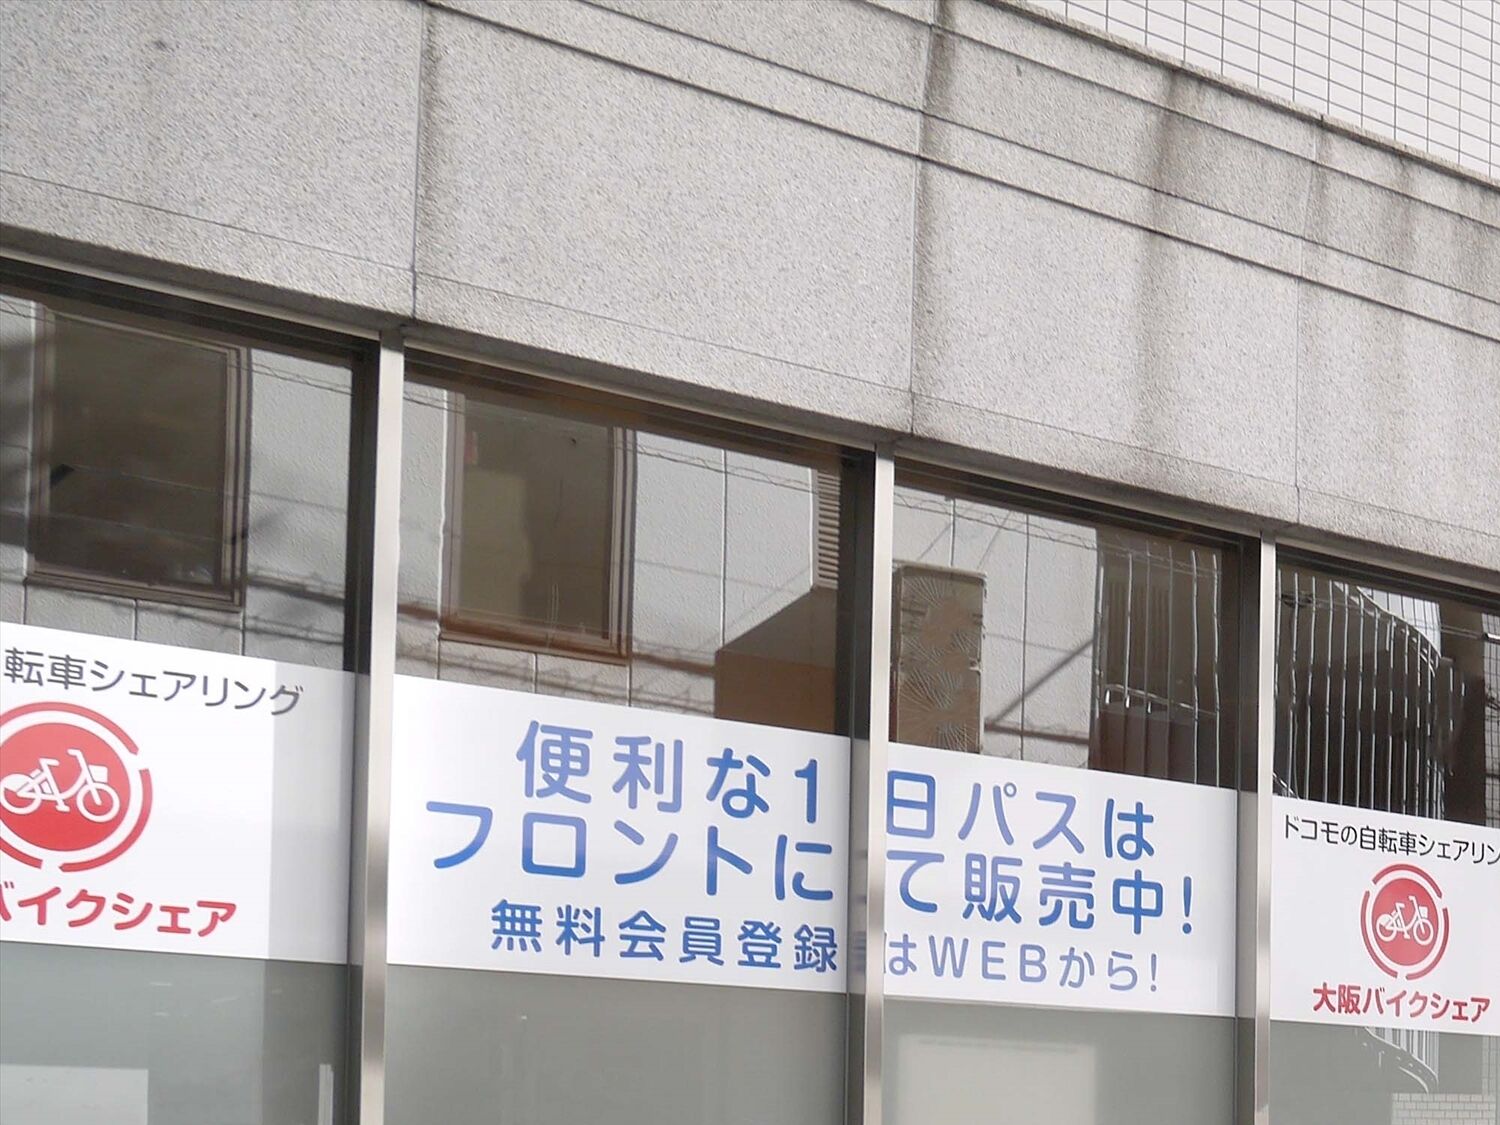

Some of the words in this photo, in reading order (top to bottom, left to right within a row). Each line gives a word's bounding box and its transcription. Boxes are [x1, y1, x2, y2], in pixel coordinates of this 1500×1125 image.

[1311, 981, 1491, 1023] 大阪バイクシェア
